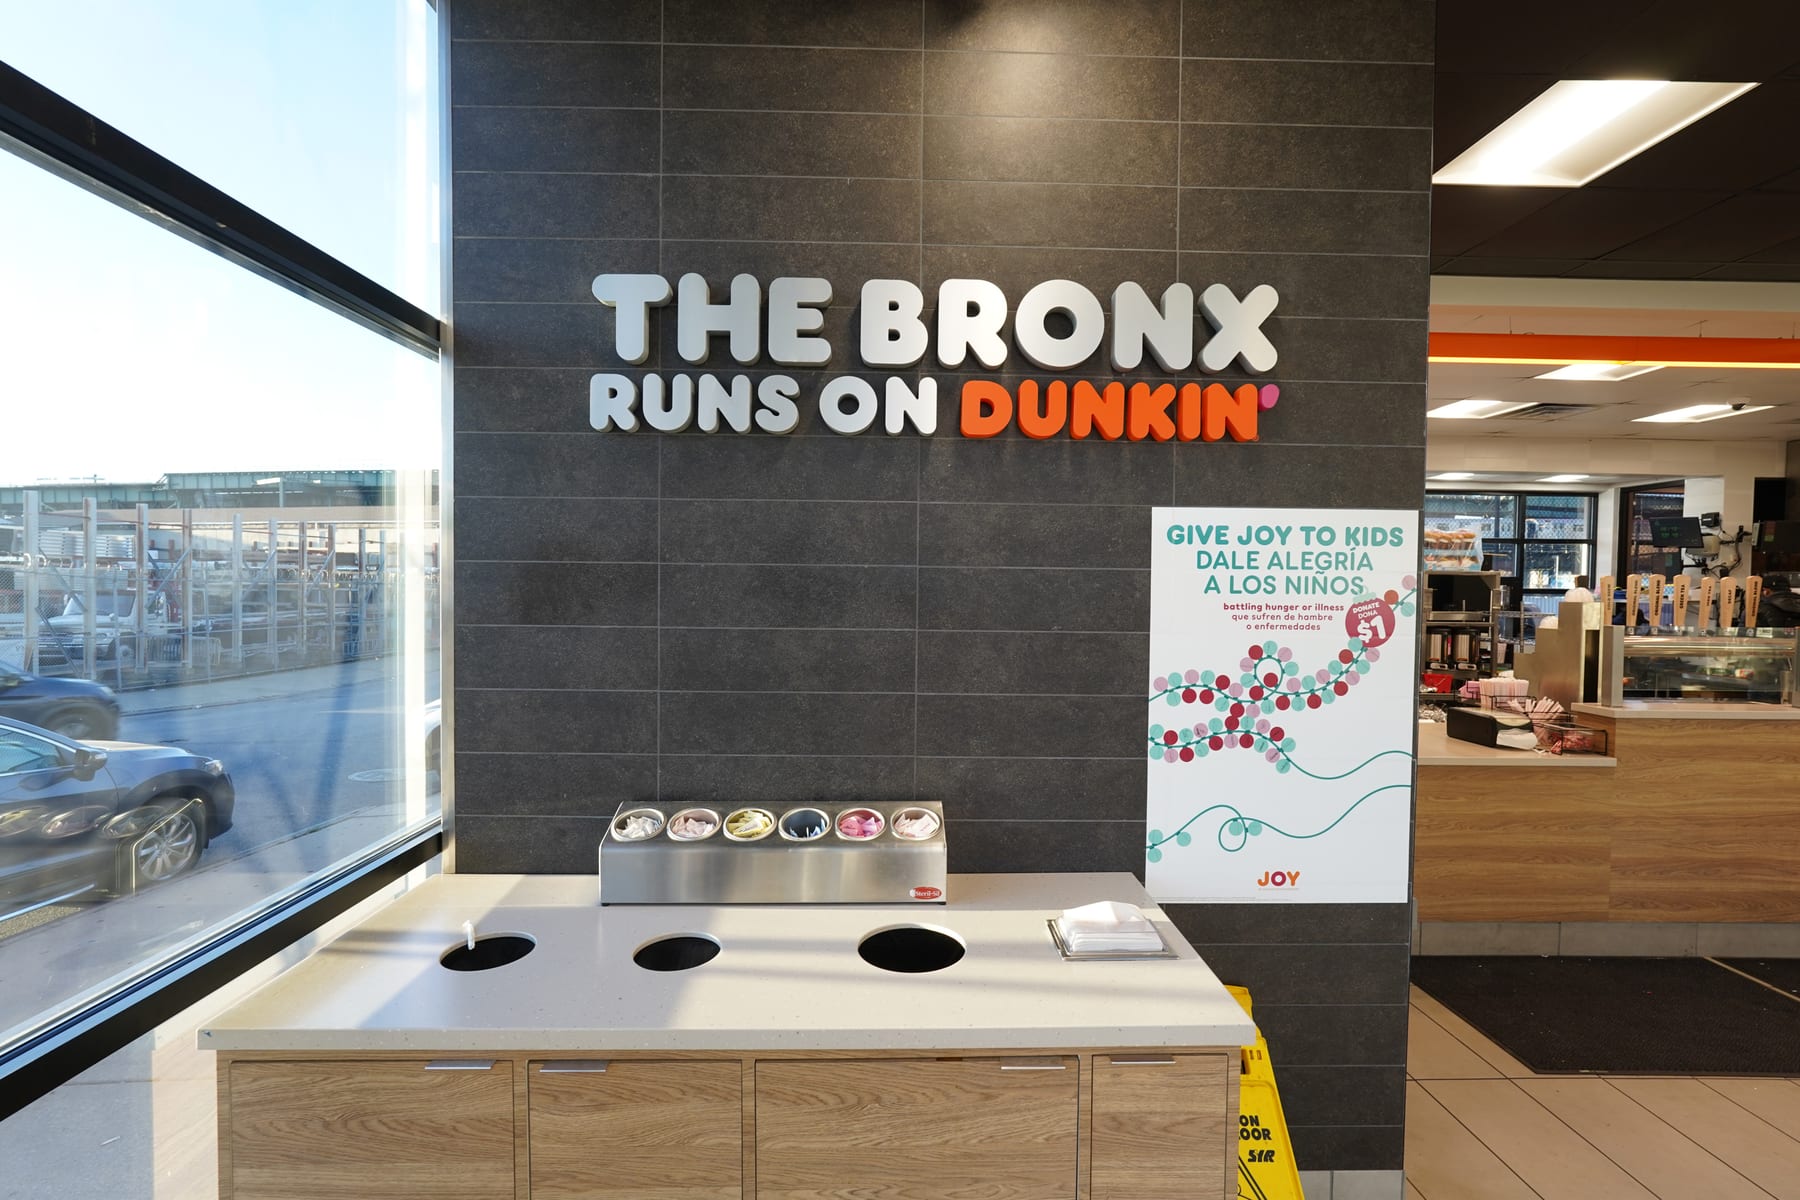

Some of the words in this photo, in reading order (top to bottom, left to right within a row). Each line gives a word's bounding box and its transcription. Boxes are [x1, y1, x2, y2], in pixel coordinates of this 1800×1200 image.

[592, 273, 832, 367] THE
[859, 278, 1279, 373] BRONX
[589, 373, 800, 434] RUNS
[819, 376, 937, 436] ON
[960, 379, 1280, 442] DUNKIN'
[1166, 524, 1230, 546] GIVE
[1237, 525, 1293, 546] JOY
[1299, 526, 1337, 547] TO
[1344, 526, 1405, 547] KIDS
[1196, 550, 1260, 571] DALE
[1266, 547, 1374, 571] ALEGRÍA
[1203, 575, 1221, 595] A
[1229, 575, 1277, 595] LOS
[1285, 570, 1365, 596] NIÑOS
[1223, 602, 1263, 612] battling
[1265, 603, 1299, 612] hunger
[1314, 603, 1345, 611] illness
[1352, 601, 1380, 614] DONATE
[1357, 609, 1378, 620] DONA
[1251, 612, 1281, 621] sufren
[1283, 613, 1295, 621] de
[1298, 613, 1333, 621] hambre
[1254, 623, 1321, 631] enfermedades
[1357, 615, 1387, 643] $1
[1257, 871, 1300, 887] JOY
[1238, 1127, 1273, 1141] OOR
[1248, 1149, 1275, 1163] SIR
